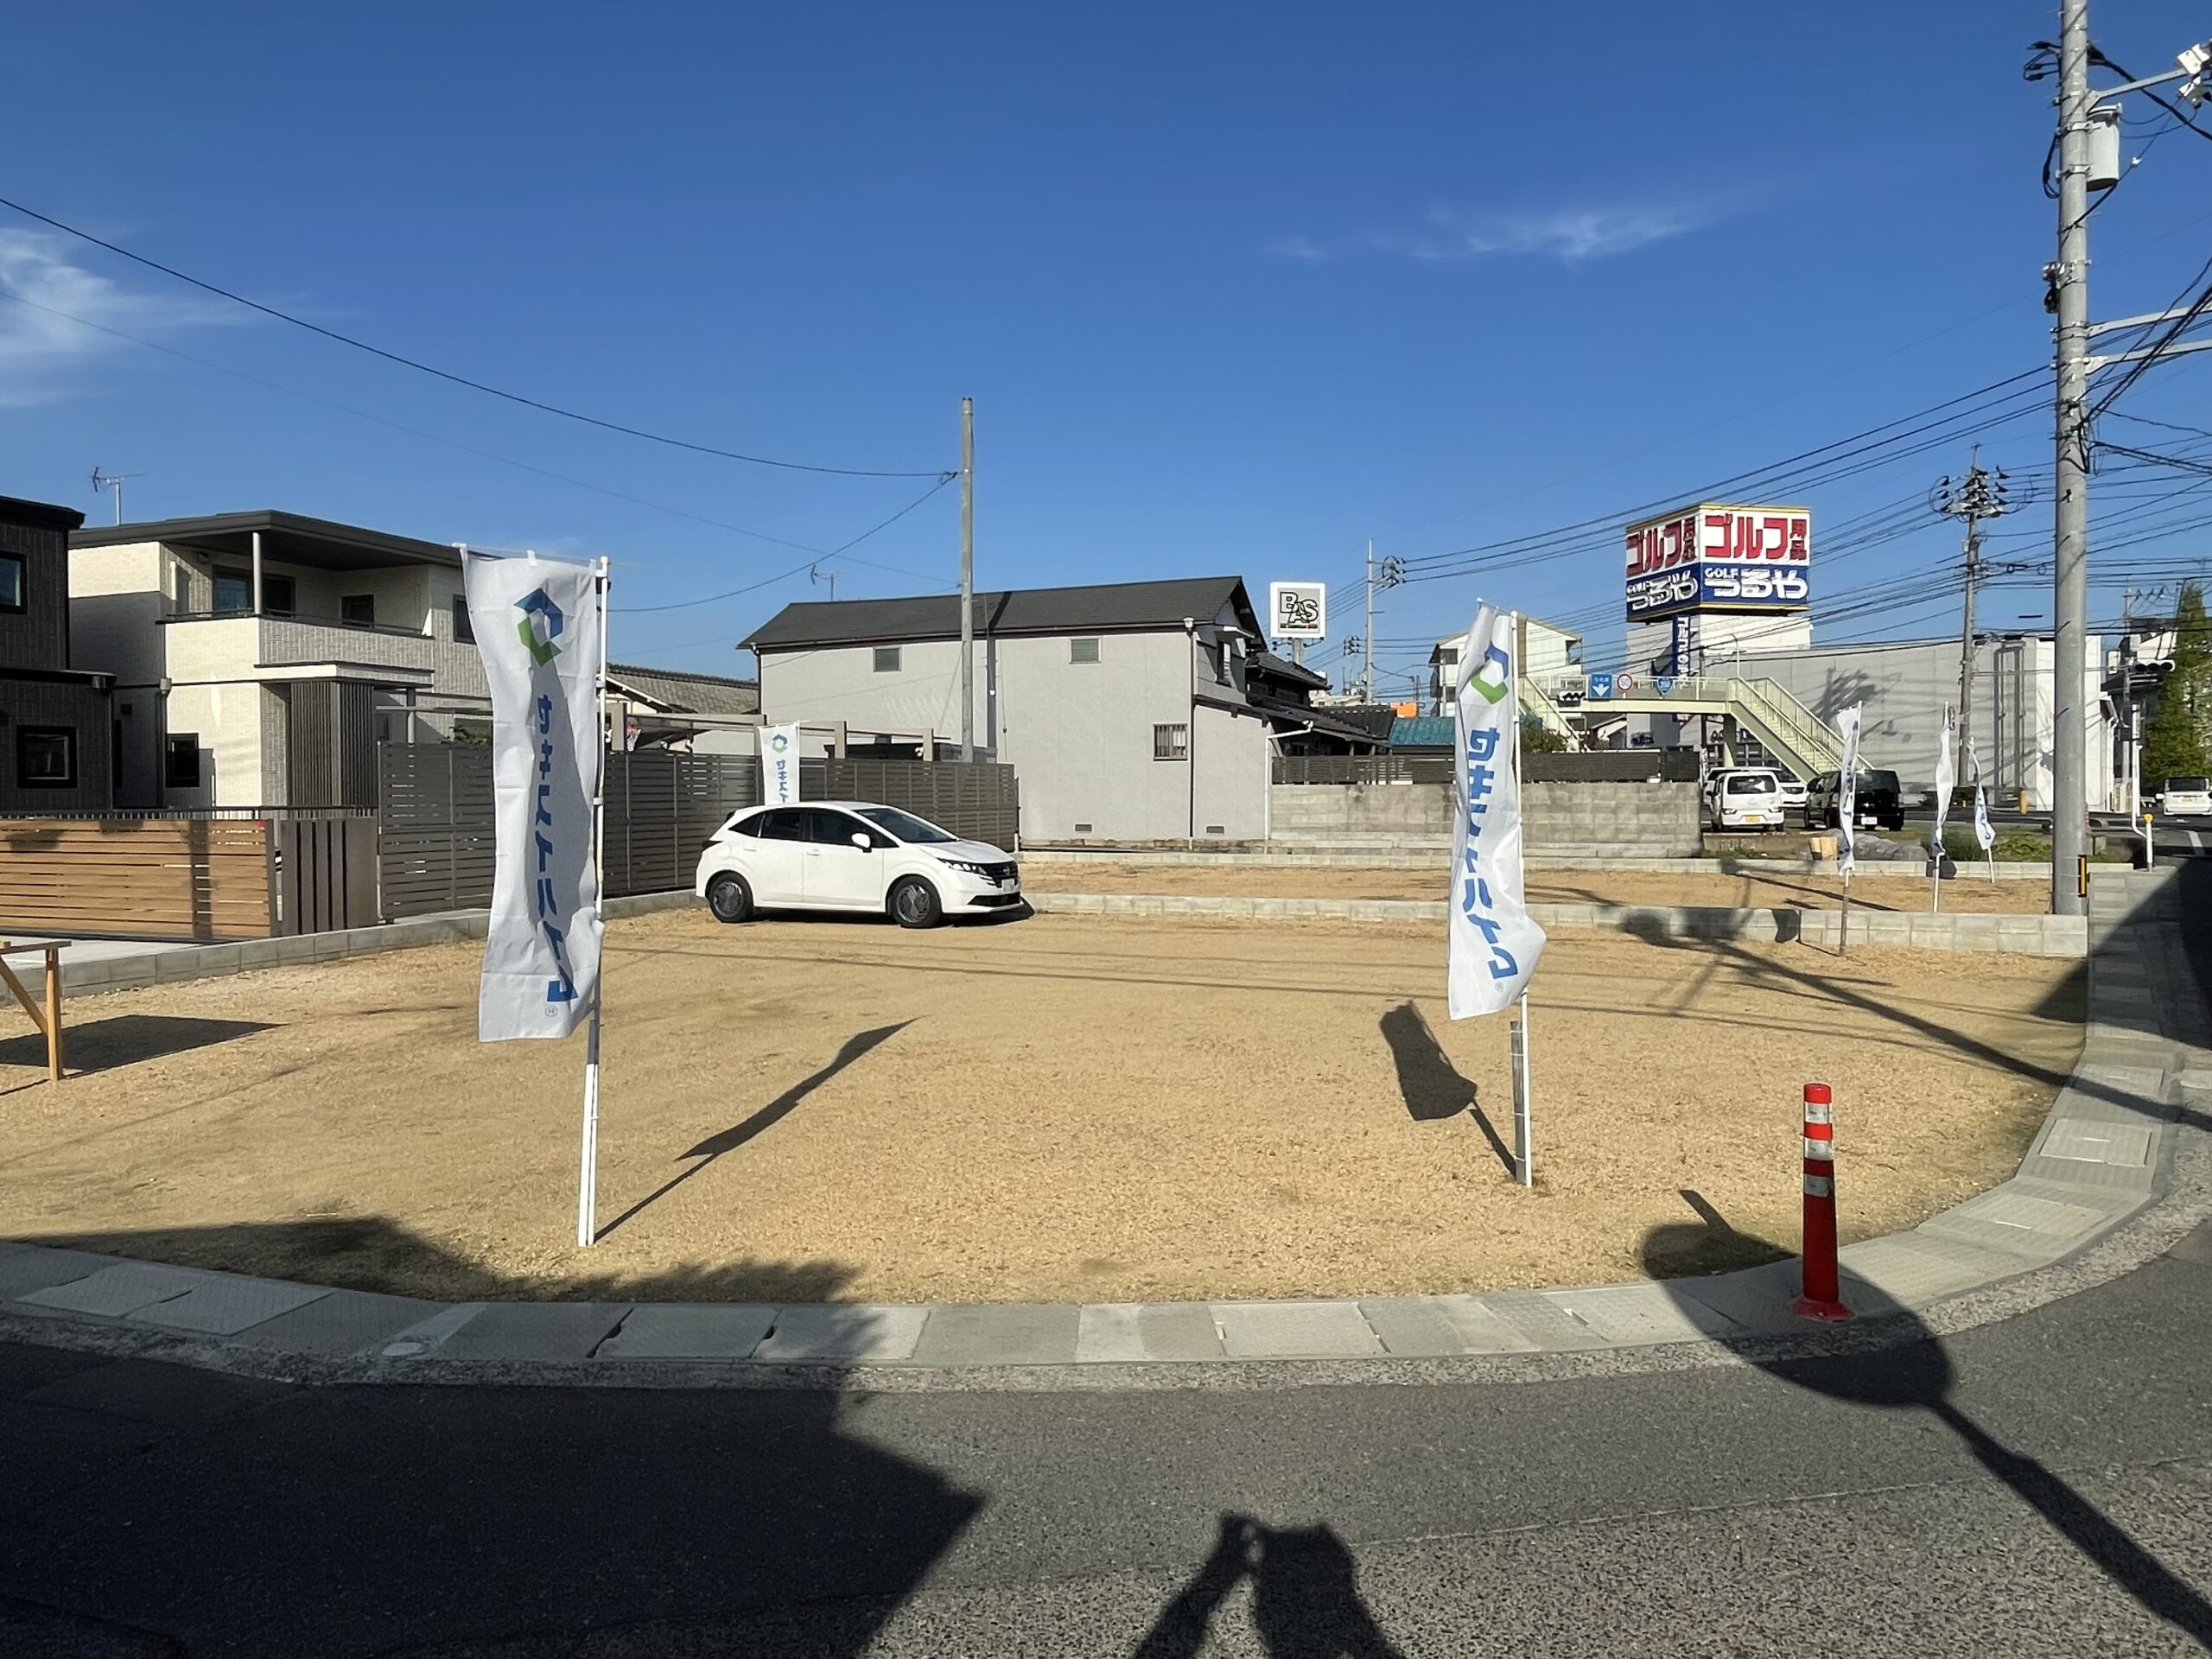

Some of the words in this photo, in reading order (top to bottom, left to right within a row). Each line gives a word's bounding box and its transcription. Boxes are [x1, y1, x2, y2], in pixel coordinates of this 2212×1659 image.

[1704, 567, 1739, 579] GOLF
[1704, 568, 1808, 600] つるや
